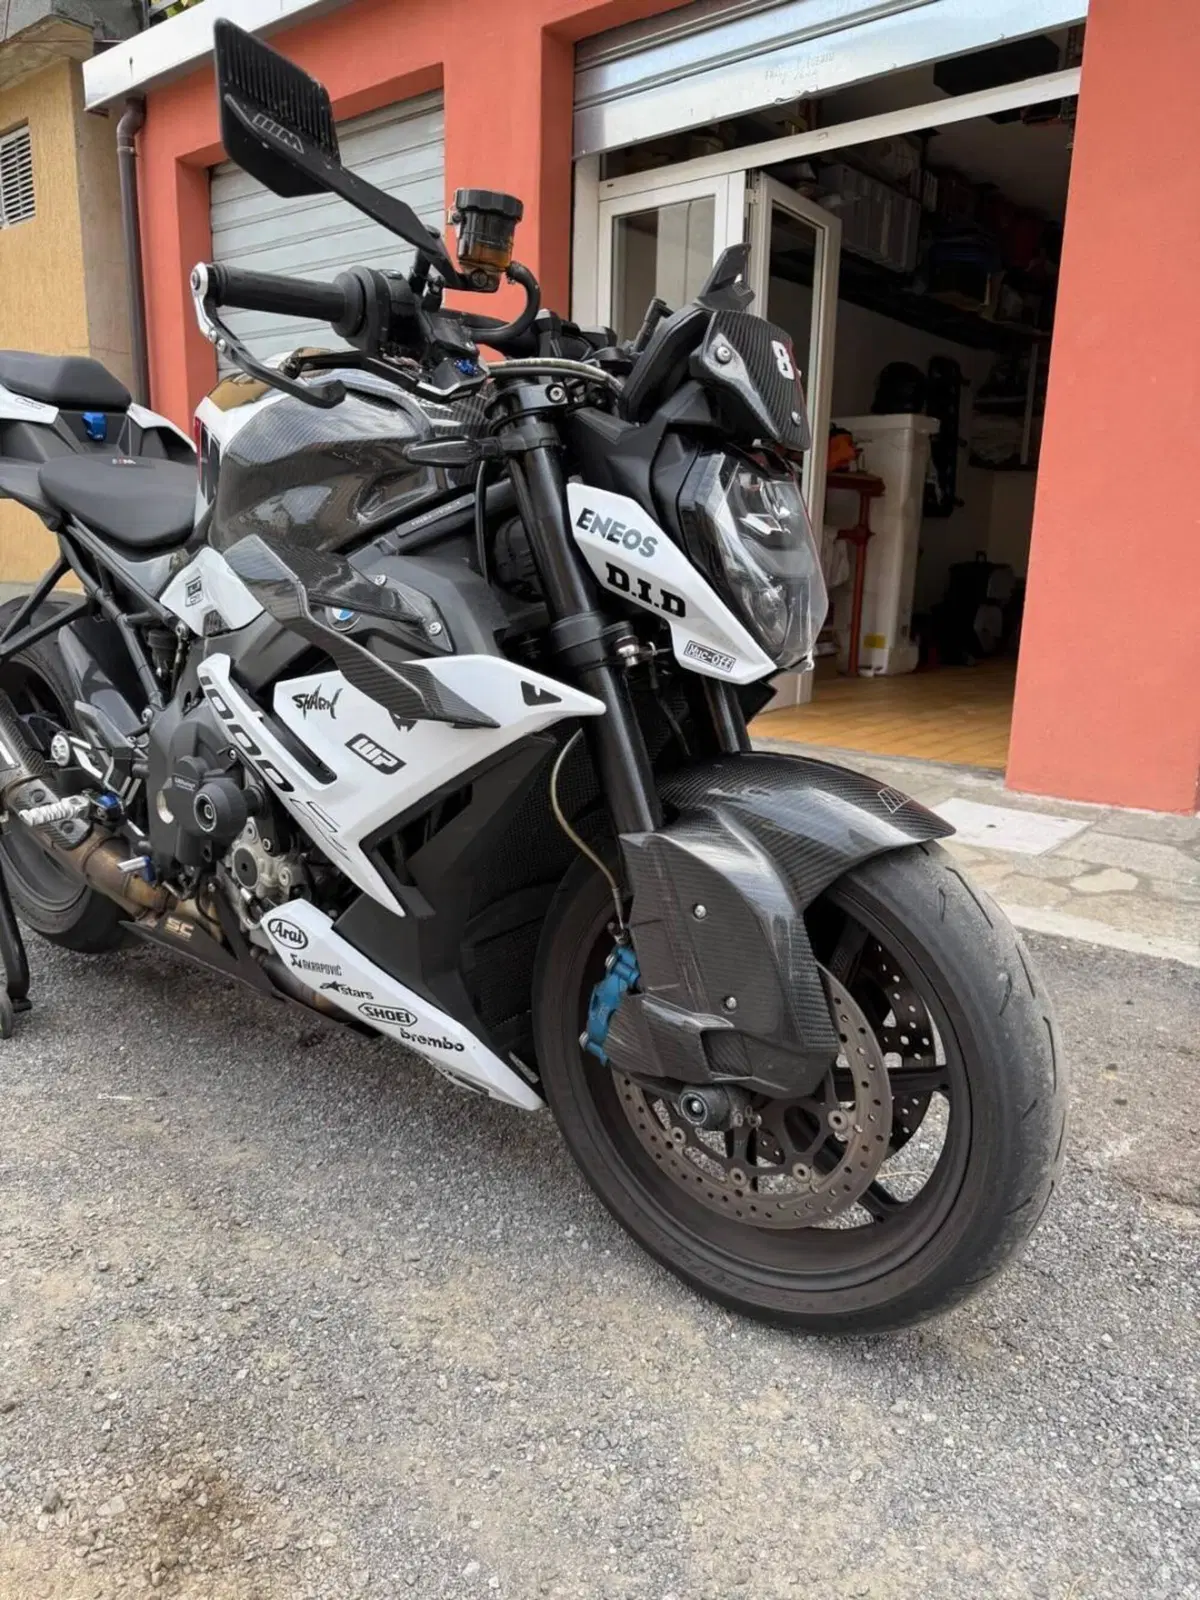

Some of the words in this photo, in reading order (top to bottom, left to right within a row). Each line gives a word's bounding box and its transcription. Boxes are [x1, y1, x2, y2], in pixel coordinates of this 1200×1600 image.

[770, 340, 795, 380] 8
[576, 507, 659, 558] ENEOS
[605, 561, 686, 618] D.I.D
[292, 683, 343, 720] SHARK
[350, 738, 400, 767] WP
[273, 921, 303, 943] Arai
[363, 1006, 411, 1023] SHOEI
[400, 1027, 465, 1052] brembo
